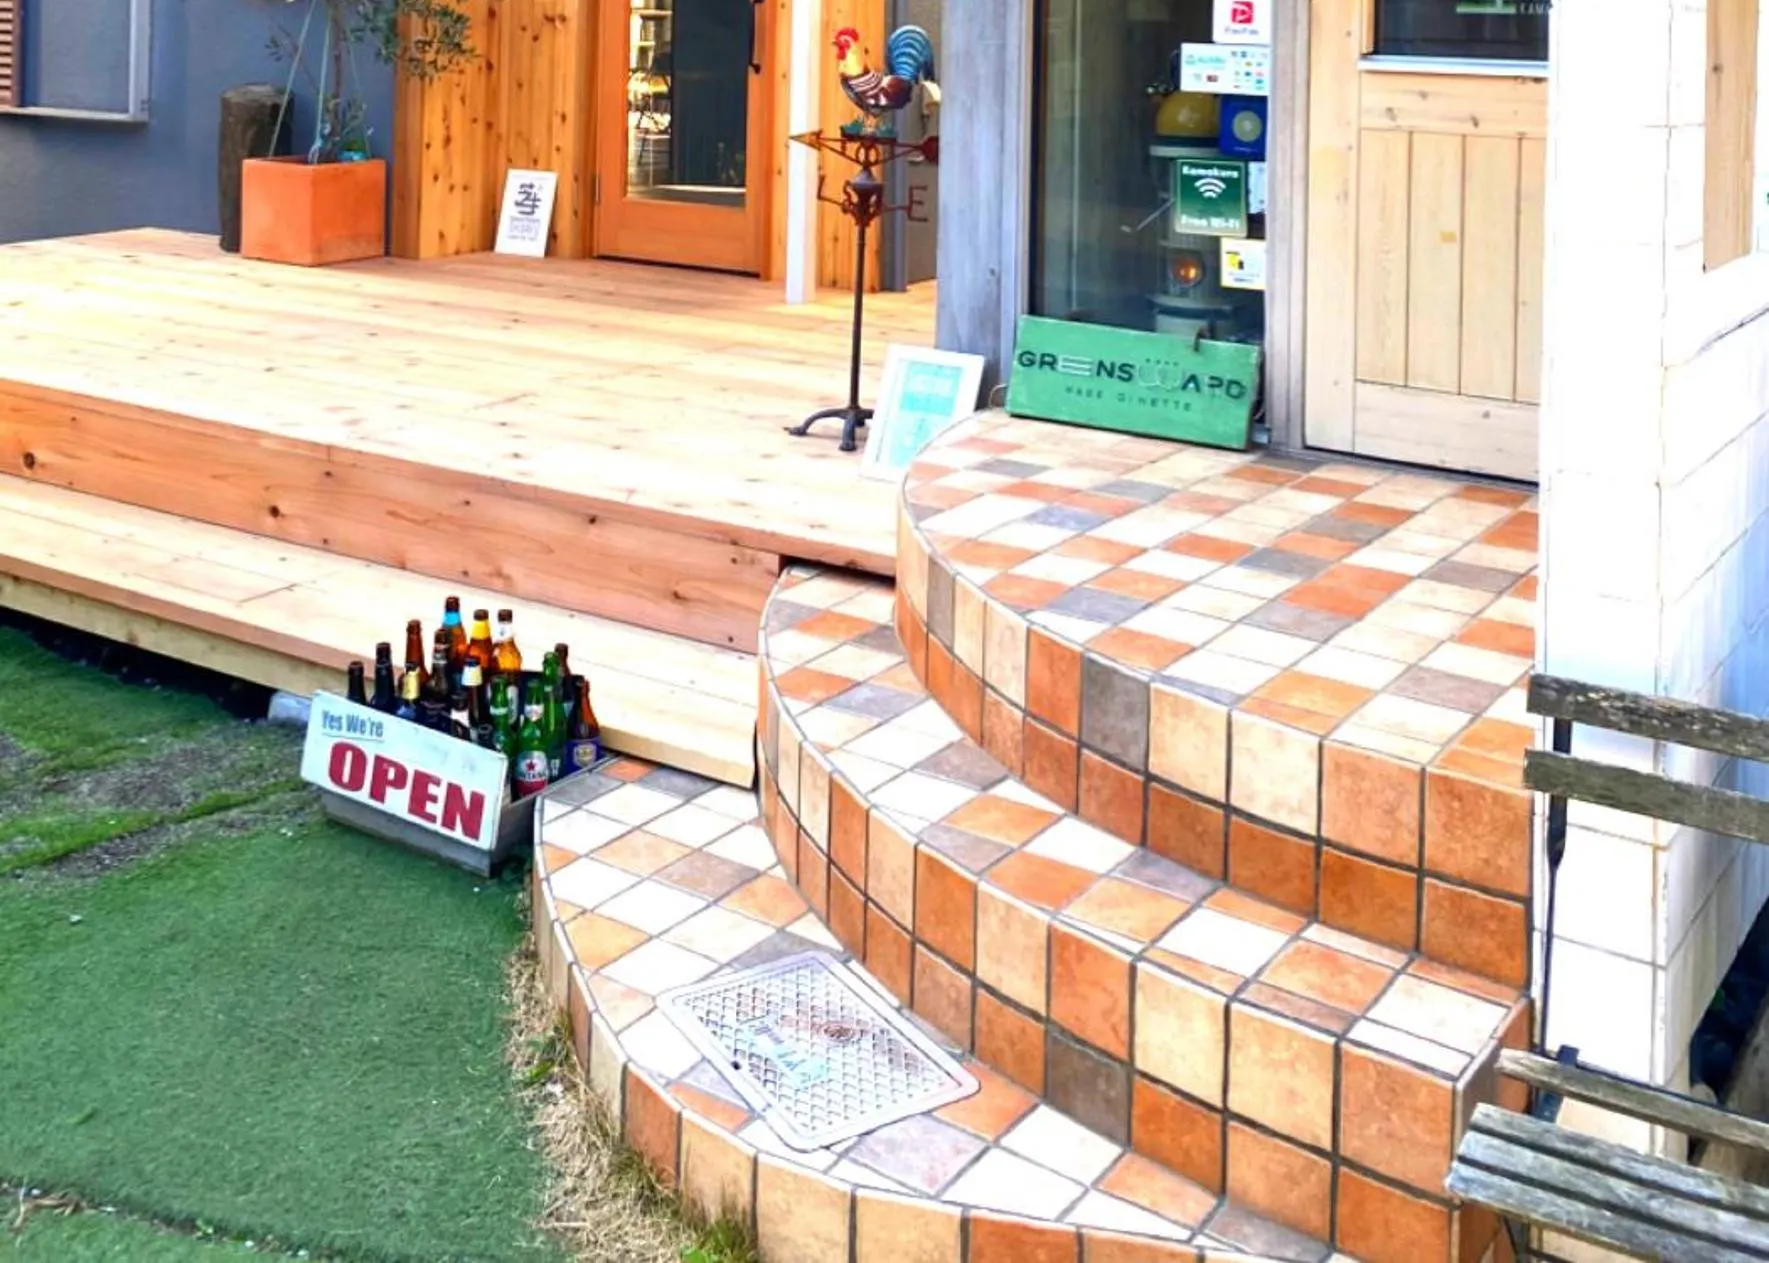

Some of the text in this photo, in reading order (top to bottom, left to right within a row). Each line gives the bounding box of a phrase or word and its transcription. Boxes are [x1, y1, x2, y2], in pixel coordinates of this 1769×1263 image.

[321, 710, 384, 738] Yes We're
[328, 740, 486, 841] OPEN
